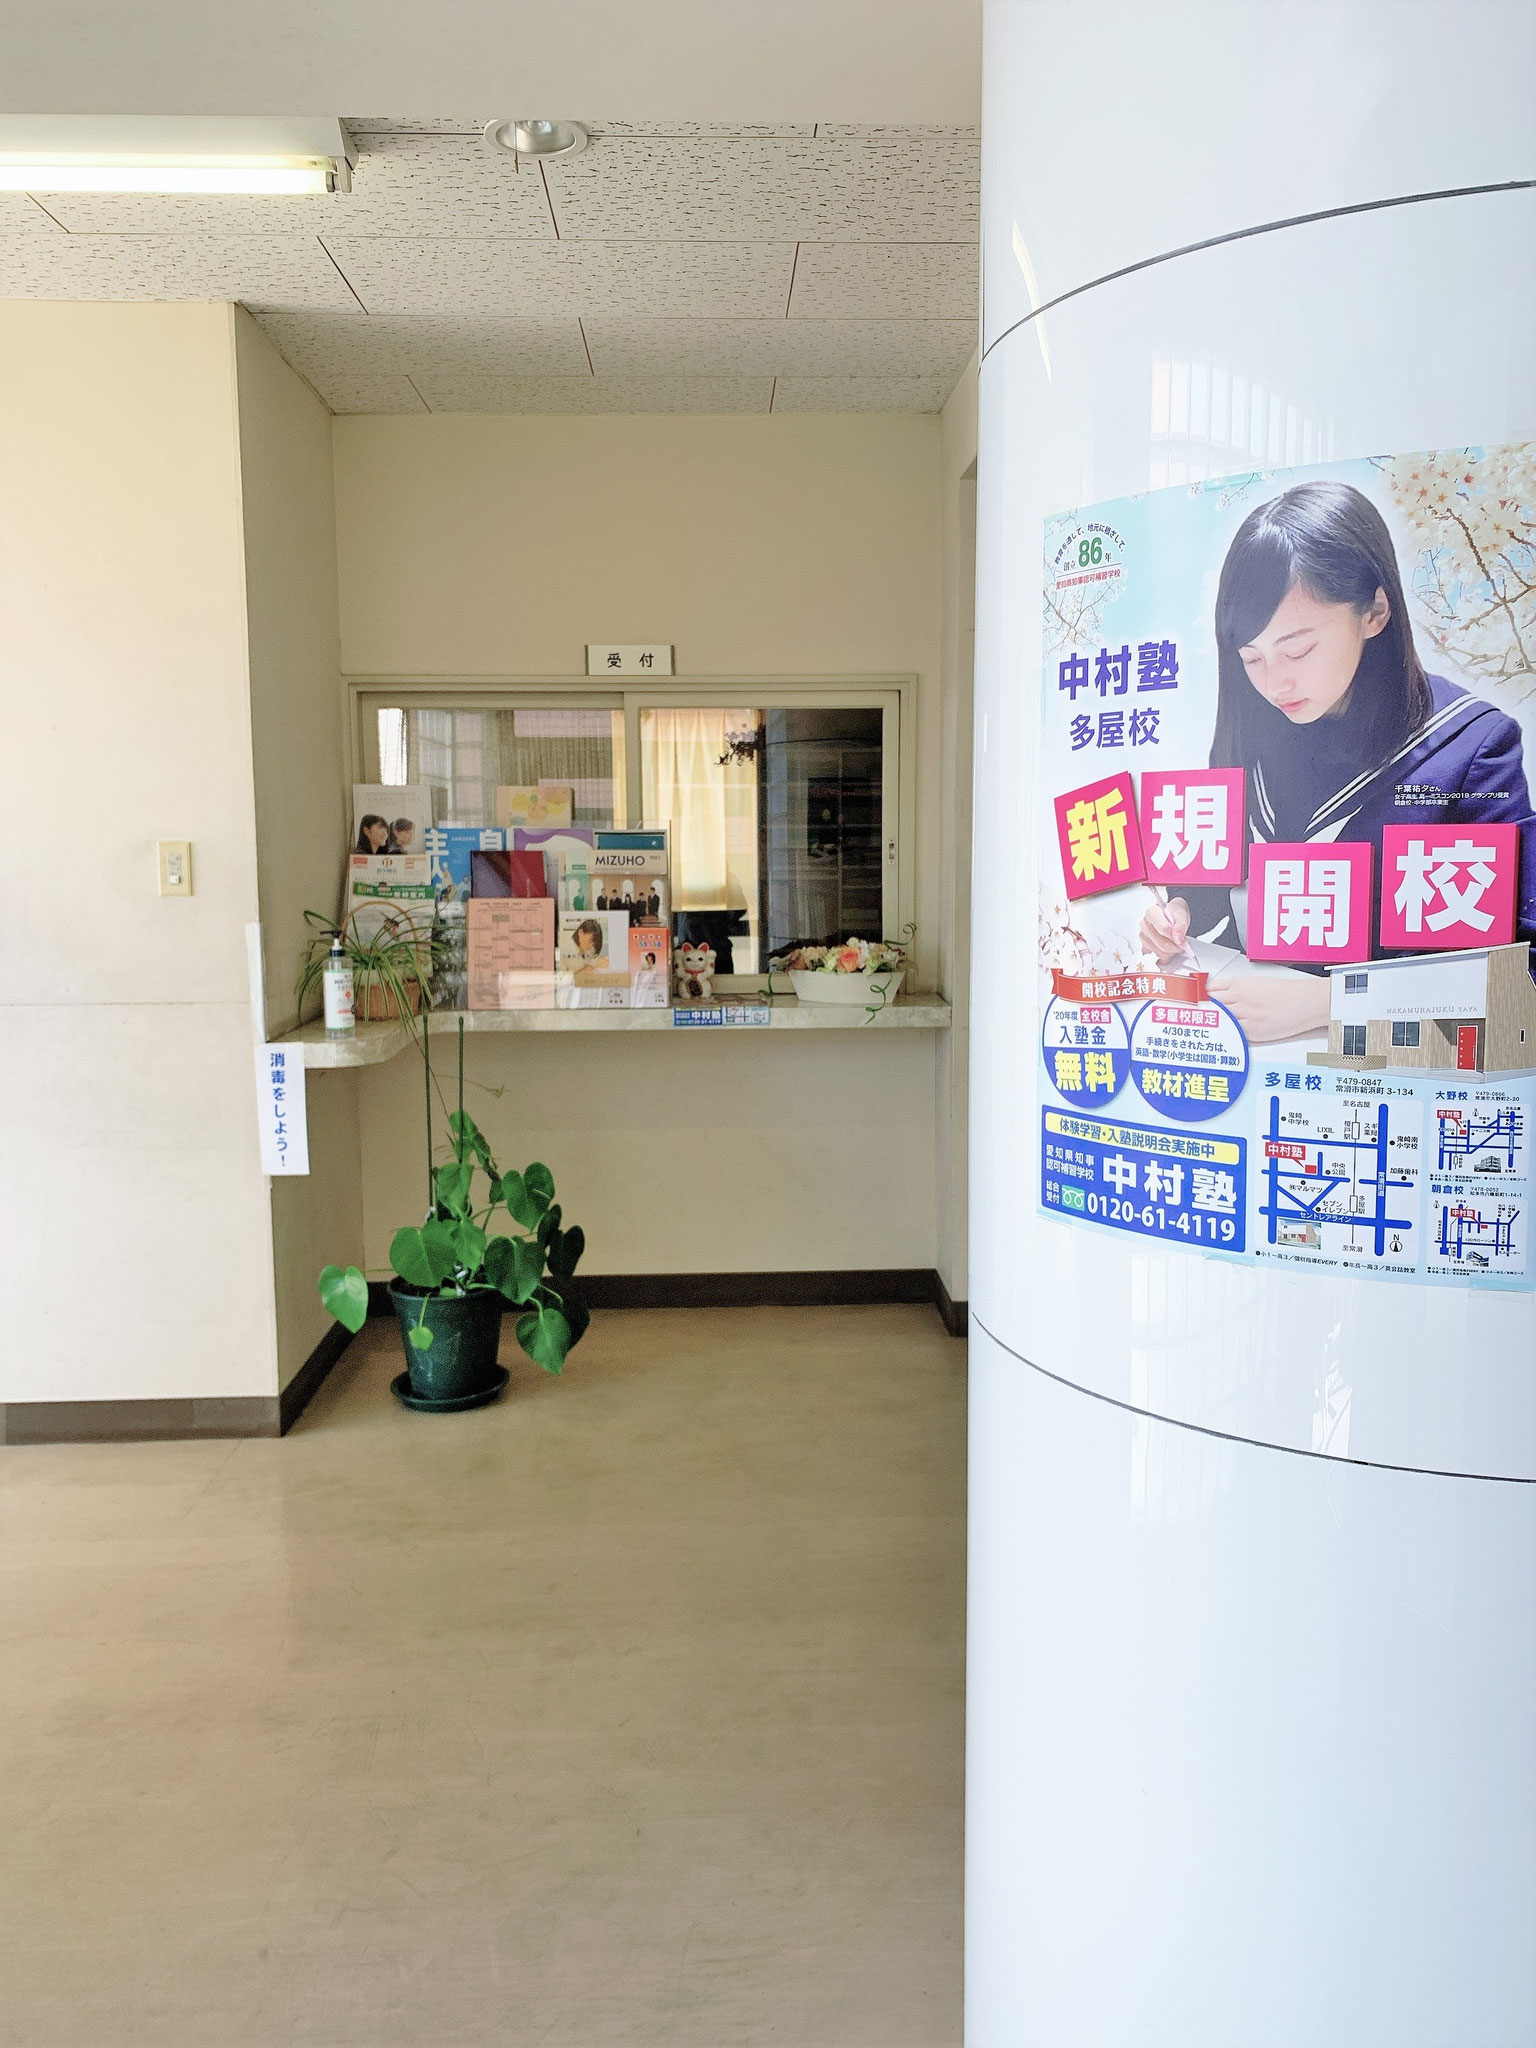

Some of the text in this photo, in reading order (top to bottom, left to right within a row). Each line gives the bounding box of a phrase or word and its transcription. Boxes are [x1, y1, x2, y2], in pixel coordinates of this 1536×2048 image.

[1078, 536, 1103, 567] 86
[1105, 552, 1112, 563] 年
[1055, 568, 1121, 590] 愛知県知事認可補習学校
[1059, 639, 1179, 700] 中村塾
[1069, 707, 1160, 751] 多屋校
[595, 856, 645, 866] MIZUHO
[1081, 977, 1167, 999] 開校記念特典
[1082, 1009, 1111, 1023] 全校舎
[1155, 1008, 1217, 1027] 多屋校限定
[1386, 1006, 1455, 1015] NAKAMURAJUKU
[1059, 1025, 1106, 1046] 入塾金
[1162, 1027, 1210, 1039] 4/30までに
[1146, 1036, 1227, 1053] 手続きをされた方は、
[1054, 1050, 1116, 1094] 無料
[1265, 1071, 1323, 1091] 多屋校
[1141, 1067, 1231, 1103] 教材進呈
[1335, 1084, 1414, 1096] 常滑市新浜町 3-134
[1336, 1076, 1382, 1087] 〒479-0847
[1435, 1091, 1468, 1101] 大野校
[270, 1053, 288, 1167] 消毒をしよう!
[1059, 1117, 1216, 1159] 体験学習・入塾説明会実施中
[1045, 1143, 1095, 1168] 愛知県知事
[1267, 1144, 1304, 1158] 中村塾
[1045, 1156, 1095, 1182] 認可補習学校
[1045, 1179, 1060, 1193] 総合
[1102, 1153, 1238, 1215] 中村塾
[1431, 1184, 1464, 1195] 朝倉校
[1045, 1191, 1060, 1205] 受付
[1322, 1199, 1343, 1207] セブン
[1087, 1192, 1237, 1242] 0120-61-4119
[1299, 1211, 1352, 1223] セントレアライン
[1322, 1206, 1349, 1215] イレブン
[1393, 1233, 1400, 1241] N
